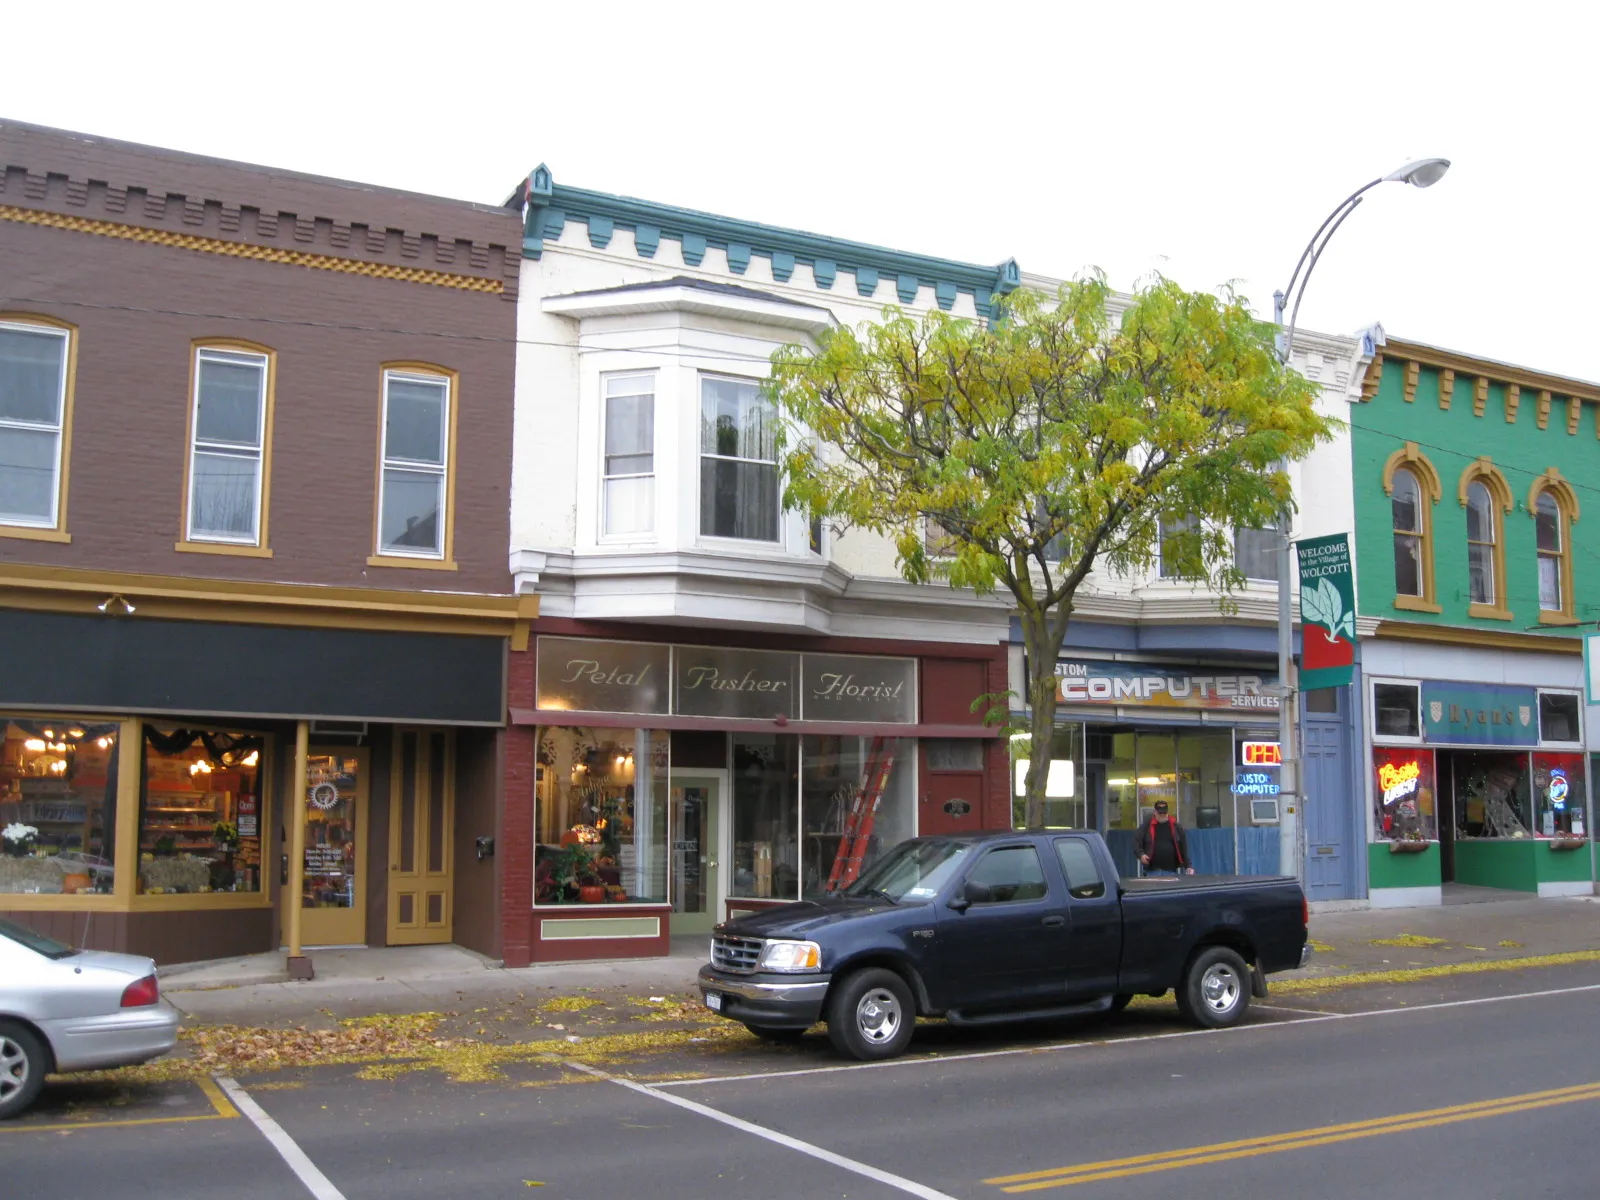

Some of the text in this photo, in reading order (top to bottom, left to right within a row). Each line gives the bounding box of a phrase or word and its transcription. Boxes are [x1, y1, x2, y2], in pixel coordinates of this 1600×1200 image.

[1299, 542, 1347, 558] WELCOME
[1318, 555, 1339, 563] Village
[1340, 552, 1348, 560] of
[1301, 562, 1349, 579] WOLCOTT
[560, 659, 904, 698] Petal Pusher Florist
[1060, 676, 1263, 701] COMPUTER
[1231, 695, 1280, 708] SERVICES
[1448, 703, 1514, 730] Ryan's
[1246, 744, 1283, 763] OPEN
[1230, 783, 1280, 795] COMPUTER
